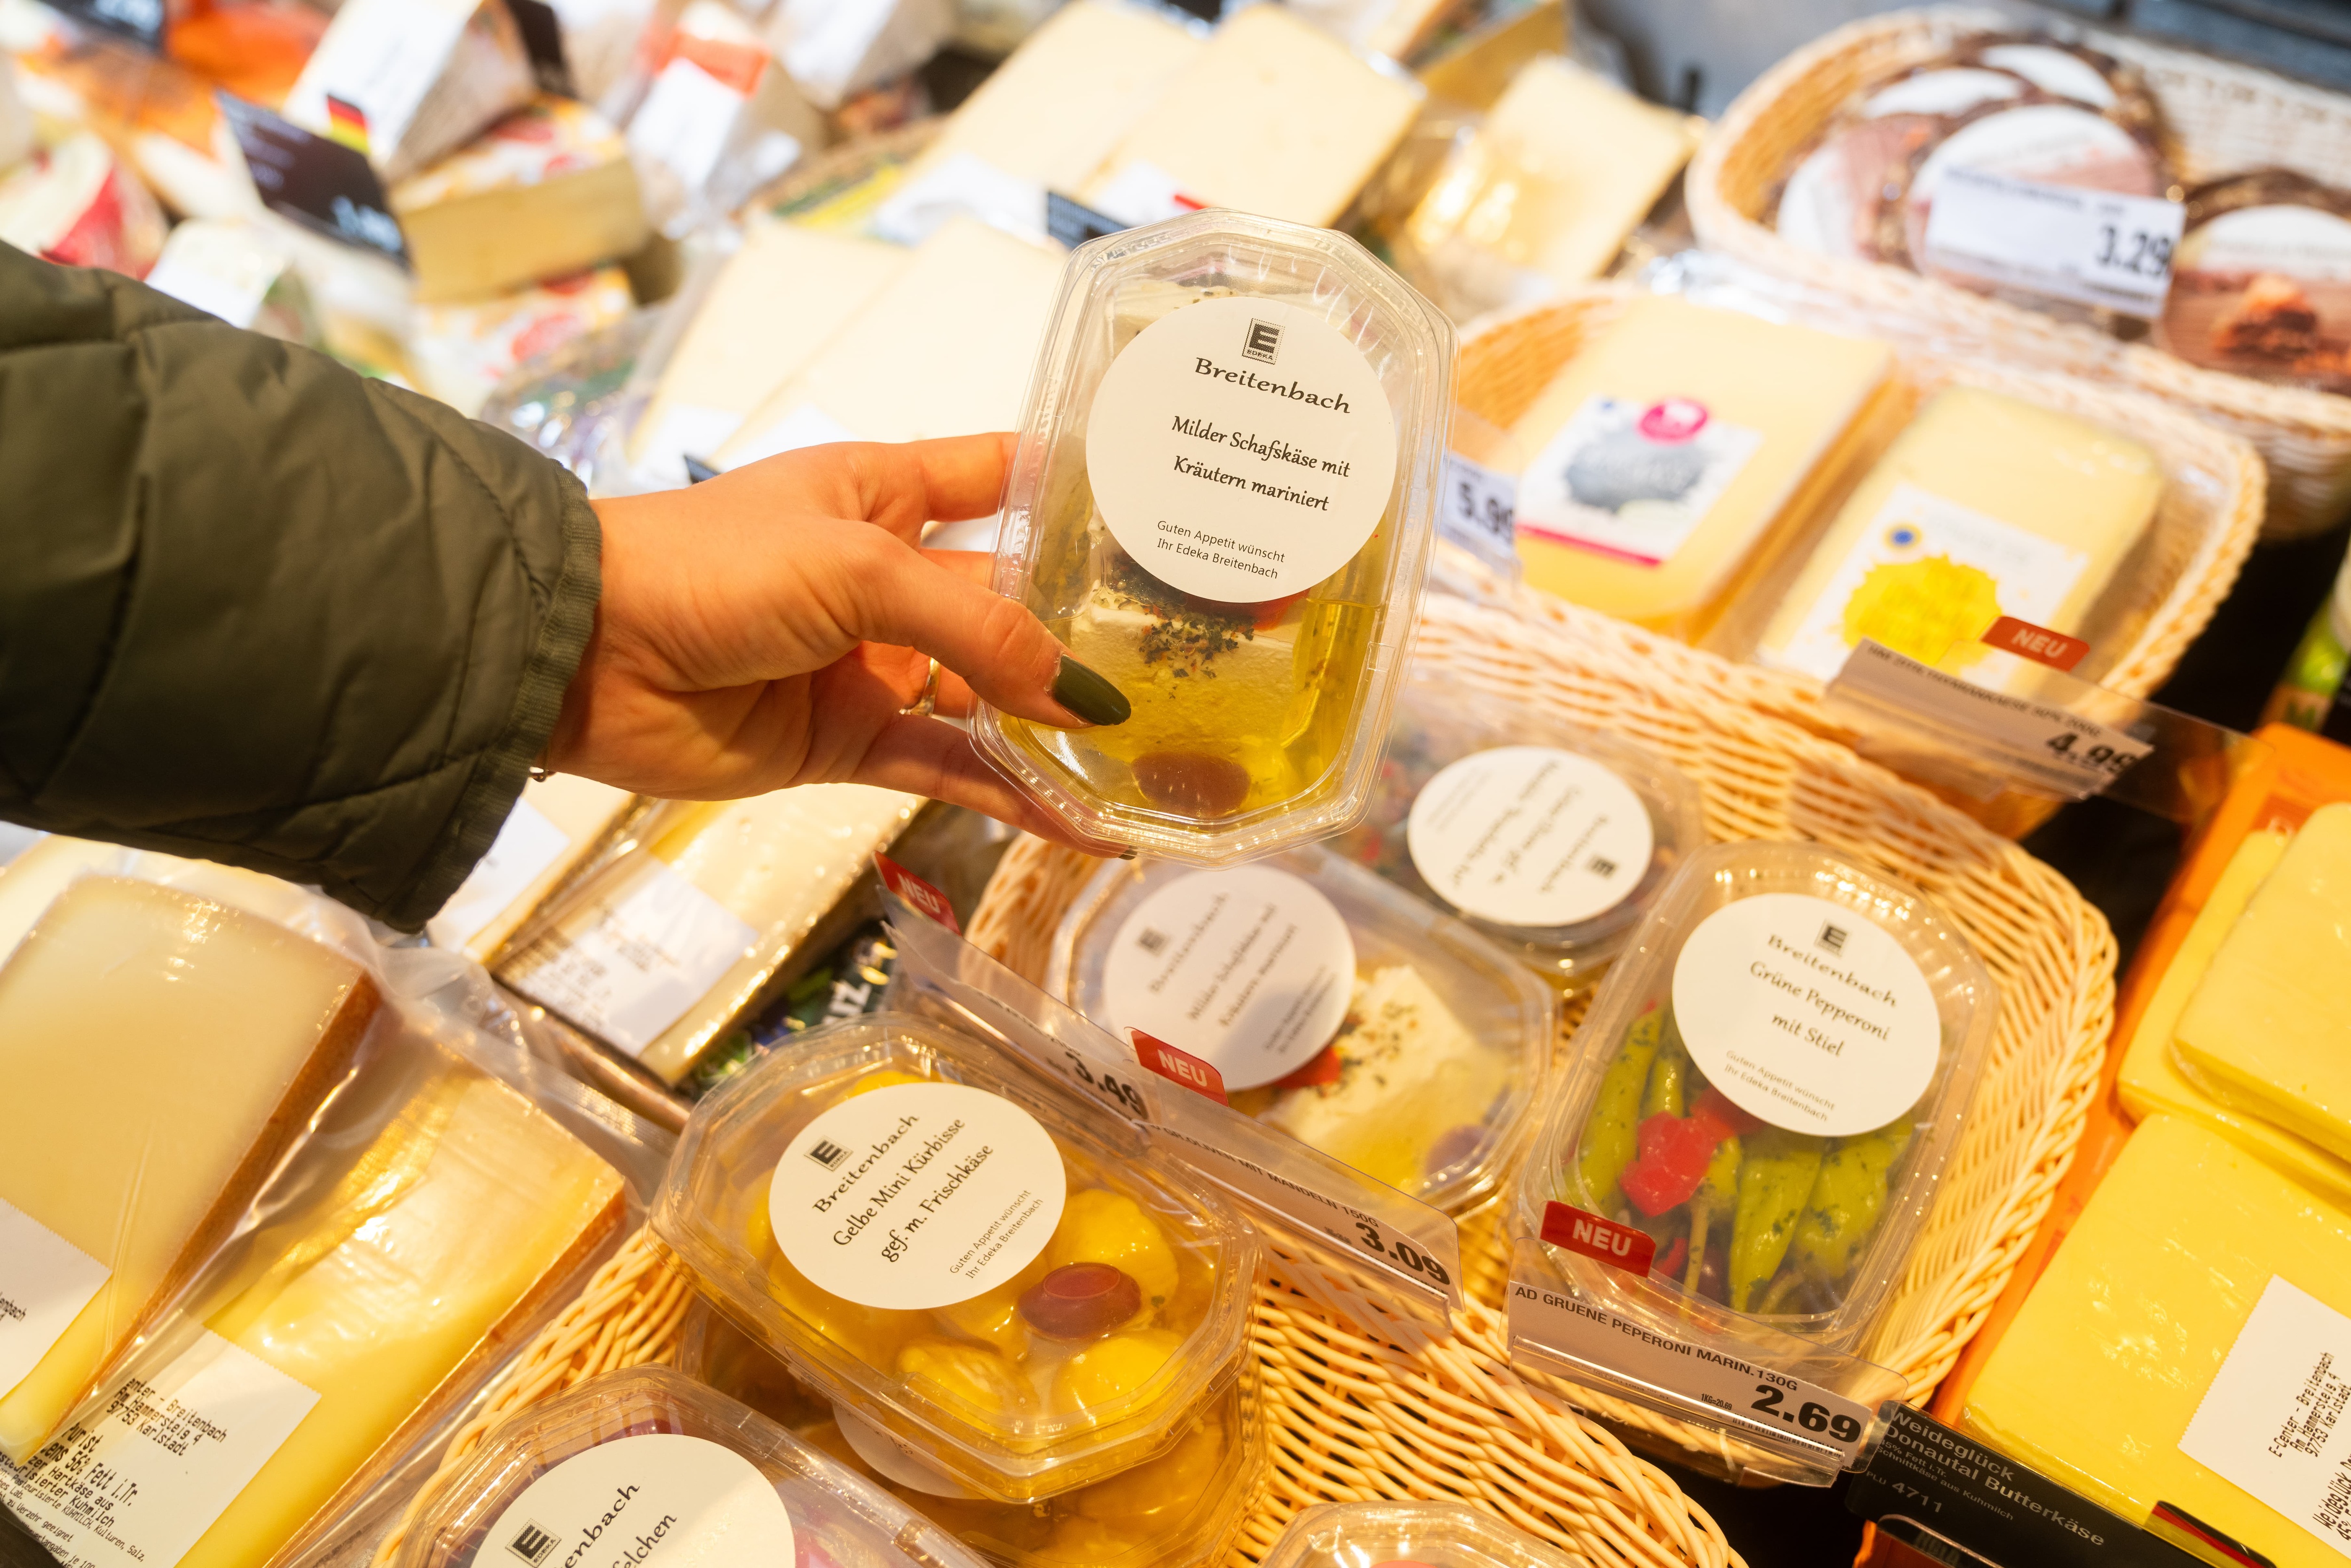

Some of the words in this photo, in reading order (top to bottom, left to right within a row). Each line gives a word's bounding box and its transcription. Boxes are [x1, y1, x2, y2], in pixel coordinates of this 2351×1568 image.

[2096, 226, 2169, 280] 3.29
[1195, 357, 1350, 414] Breitenbach
[1171, 416, 1227, 444] Milder
[1230, 432, 1318, 469] Schafskäse
[1322, 460, 1351, 477] mit
[1174, 455, 1246, 489] Kräutern
[1252, 480, 1330, 511] mariniert
[1157, 520, 1191, 538] Guten
[1193, 530, 1236, 551] Appetit
[1238, 543, 1286, 563] wünscht
[1157, 538, 1174, 551] Ihr
[1176, 543, 1209, 561] Edeka
[1212, 552, 1278, 580] Breitenbach
[2011, 627, 2069, 658] NEU
[897, 873, 939, 913] NEU
[1767, 934, 1898, 1007] Breitenbach
[1750, 960, 1802, 996] Grüne
[1806, 988, 1891, 1042] Pepperoni
[1771, 1014, 1802, 1036] mit
[1804, 1028, 1846, 1056] Stiel
[1065, 1051, 1149, 1120] 3.49
[1157, 1048, 1207, 1087] NEU
[1724, 1064, 1739, 1076] Ihr
[1740, 1072, 1769, 1092] Edeka
[1770, 1087, 1828, 1122] Breitenbach
[1726, 1050, 1755, 1070] Guten
[1757, 1066, 1793, 1089] Appetit
[1794, 1082, 1836, 1111] wünscht
[812, 1115, 920, 1213] Breitenbach
[833, 1207, 877, 1245] Gelbe
[869, 1173, 911, 1208] Mini
[902, 1119, 965, 1174] Kürbisse
[881, 1229, 908, 1262] gef.
[905, 1217, 928, 1233] m.
[919, 1143, 994, 1213] Frischkäse
[1238, 1158, 1263, 1175] MIT
[1268, 1172, 1339, 1211] MANDELN
[1341, 1206, 1380, 1228] 150G
[950, 1248, 975, 1273] Guten
[973, 1221, 1002, 1250] Appetit
[1000, 1190, 1032, 1221] wünscht
[965, 1265, 980, 1279] Ihr
[977, 1242, 1003, 1266] Edeka
[999, 1198, 1044, 1242] Breitenbach
[1356, 1222, 1450, 1285] 3.09
[1572, 1218, 1633, 1257] NEU
[1515, 1285, 1538, 1301] AD
[1543, 1293, 1608, 1325] GRUENE
[1611, 1318, 1693, 1356] PEPERONI
[1701, 1393, 1733, 1411] 1KG=20.69
[2327, 1371, 2341, 1380] 4
[107, 1400, 140, 1426] 97753
[136, 1418, 189, 1456] Karlstadt
[114, 1386, 130, 1403] Am
[129, 1395, 190, 1440] Hammersteig
[192, 1433, 204, 1446] 4
[166, 1399, 227, 1443] Breitenbach
[1750, 1383, 1862, 1444] 2.69
[2268, 1416, 2299, 1458] E-Center
[2295, 1352, 2335, 1406] Breitenbach
[2296, 1383, 2336, 1438] Hammersteig
[2304, 1427, 2328, 1458] 97753
[2319, 1383, 2351, 1429] Karlstadt
[1890, 1409, 2016, 1481] Weideglück
[1904, 1451, 1927, 1467] Fett
[1928, 1463, 1948, 1478] i.Tr.
[2289, 1438, 2306, 1452] Am
[9, 1486, 24, 1500] Lab.
[48, 1466, 94, 1499] Hartkäse
[94, 1496, 114, 1511] aus
[65, 1450, 90, 1475] 56%
[84, 1462, 117, 1490] Fett
[110, 1478, 138, 1506] i.Tr.
[1866, 1471, 1887, 1485] PLU
[1892, 1482, 1943, 1513] 4711
[1876, 1446, 1938, 1481] Schnittkäse
[1940, 1479, 1960, 1493] aus
[1963, 1489, 2014, 1521] Kuhmilch
[1885, 1425, 1980, 1481] Donautal
[1983, 1476, 2105, 1546] Butterkäse
[2312, 1472, 2351, 1530] Weideglück
[7, 1498, 14, 1508] zu
[16, 1504, 42, 1522] Verzehr
[41, 1520, 75, 1543] geeignet
[12, 1473, 62, 1509] Pasteurisierte
[61, 1505, 94, 1530] KUHMILCH,
[94, 1524, 125, 1550] Kulturen,
[127, 1545, 145, 1563] Salz,
[69, 1495, 115, 1528] Kuhmilch
